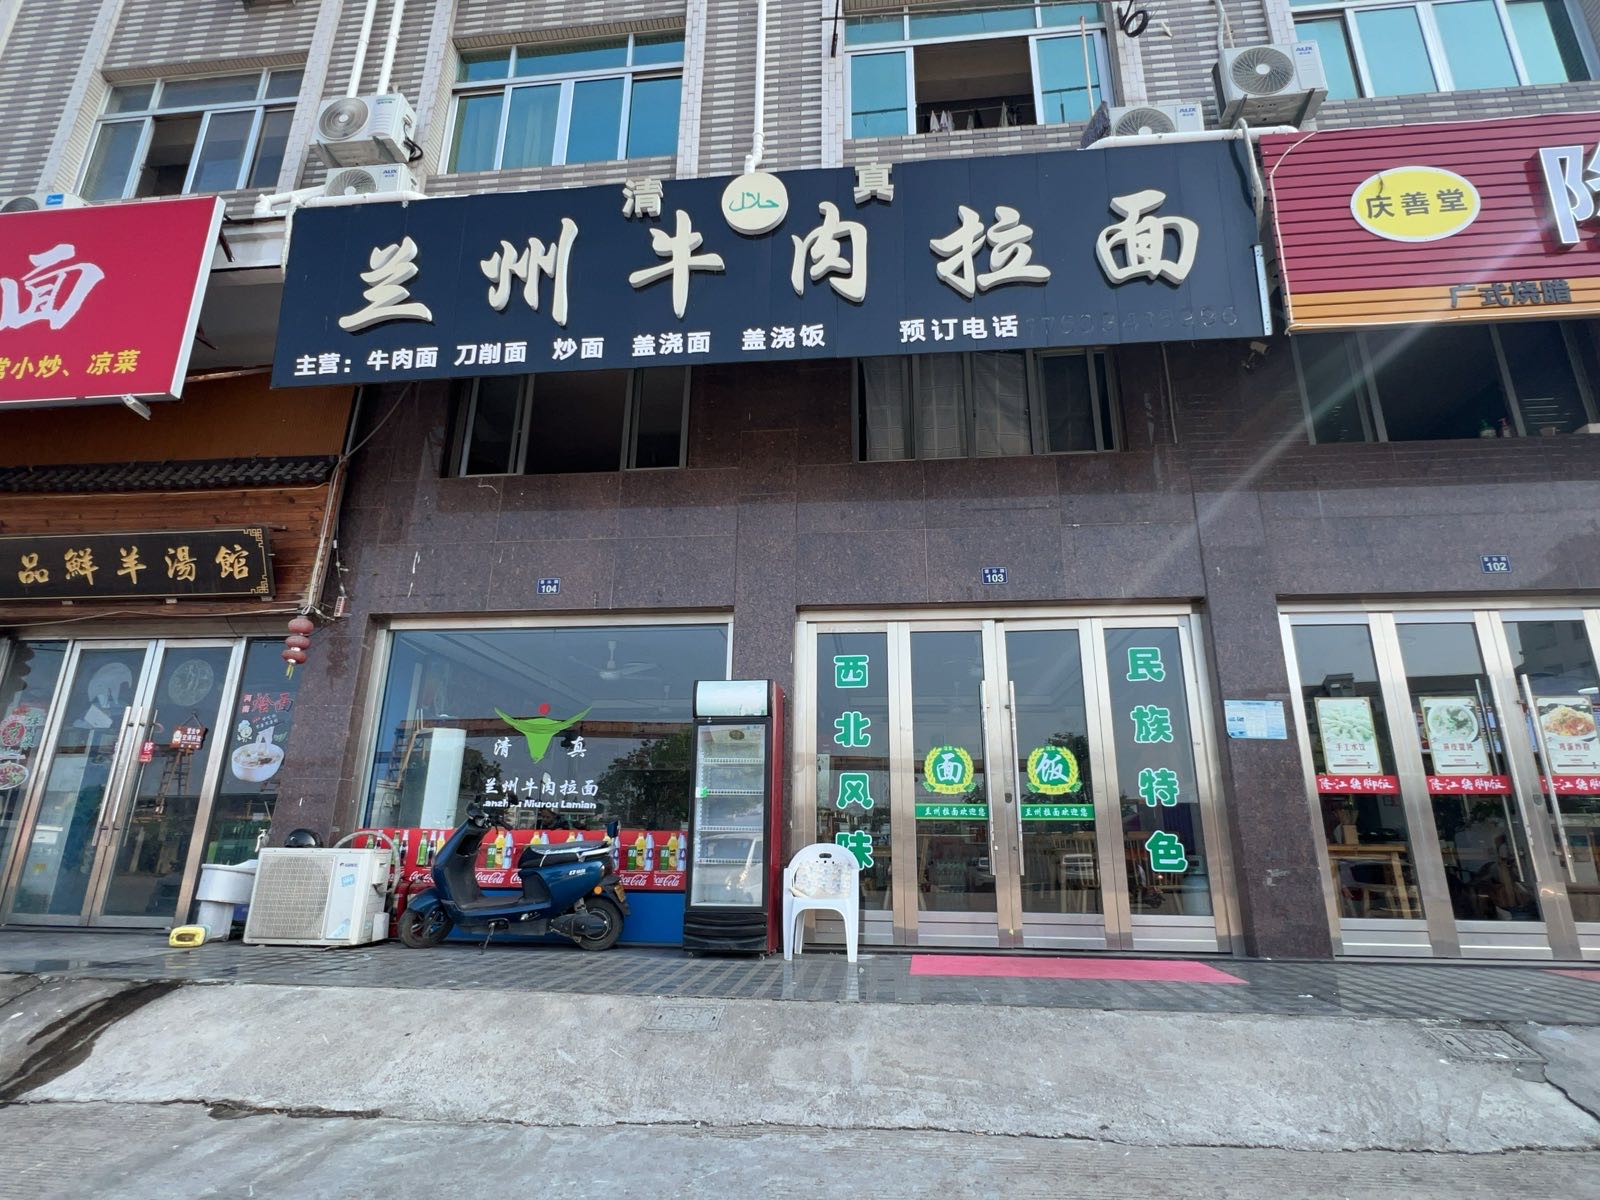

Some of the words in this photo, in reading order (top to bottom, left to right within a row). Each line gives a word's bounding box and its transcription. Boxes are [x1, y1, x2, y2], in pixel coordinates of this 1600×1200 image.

[853, 162, 894, 204] 真
[622, 178, 664, 218] 清
[728, 191, 779, 212] حلال
[1366, 188, 1468, 219] 庆善堂
[338, 188, 1199, 332] 兰州牛肉拉面
[0, 243, 105, 330] 面
[1449, 279, 1572, 308] 广式烧腊
[366, 347, 438, 372] 牛肉面
[454, 341, 528, 366] 刀削面
[552, 337, 605, 361] 炒面
[632, 331, 711, 357] 盖浇面
[741, 324, 826, 351] 盖浇饭
[900, 315, 1018, 343] 预订电话
[87, 350, 140, 375] 凉菜
[17, 544, 249, 585] 品鮮羊湯館
[986, 574, 1004, 582] 103
[1486, 562, 1508, 571] 102
[494, 737, 512, 757] 清
[568, 736, 587, 757] 真
[1127, 647, 1188, 872] 民族特色
[834, 655, 874, 870] 西北风味
[937, 753, 962, 783] 面
[1036, 752, 1069, 783] 饭
[485, 777, 598, 796] 兰州牛肉拉面
[524, 800, 558, 808] Niurou
[561, 801, 596, 809] Lamian
[924, 807, 986, 817] 兰州拉面欢迎您
[1025, 808, 1088, 817] 兰州拉面欢迎您
